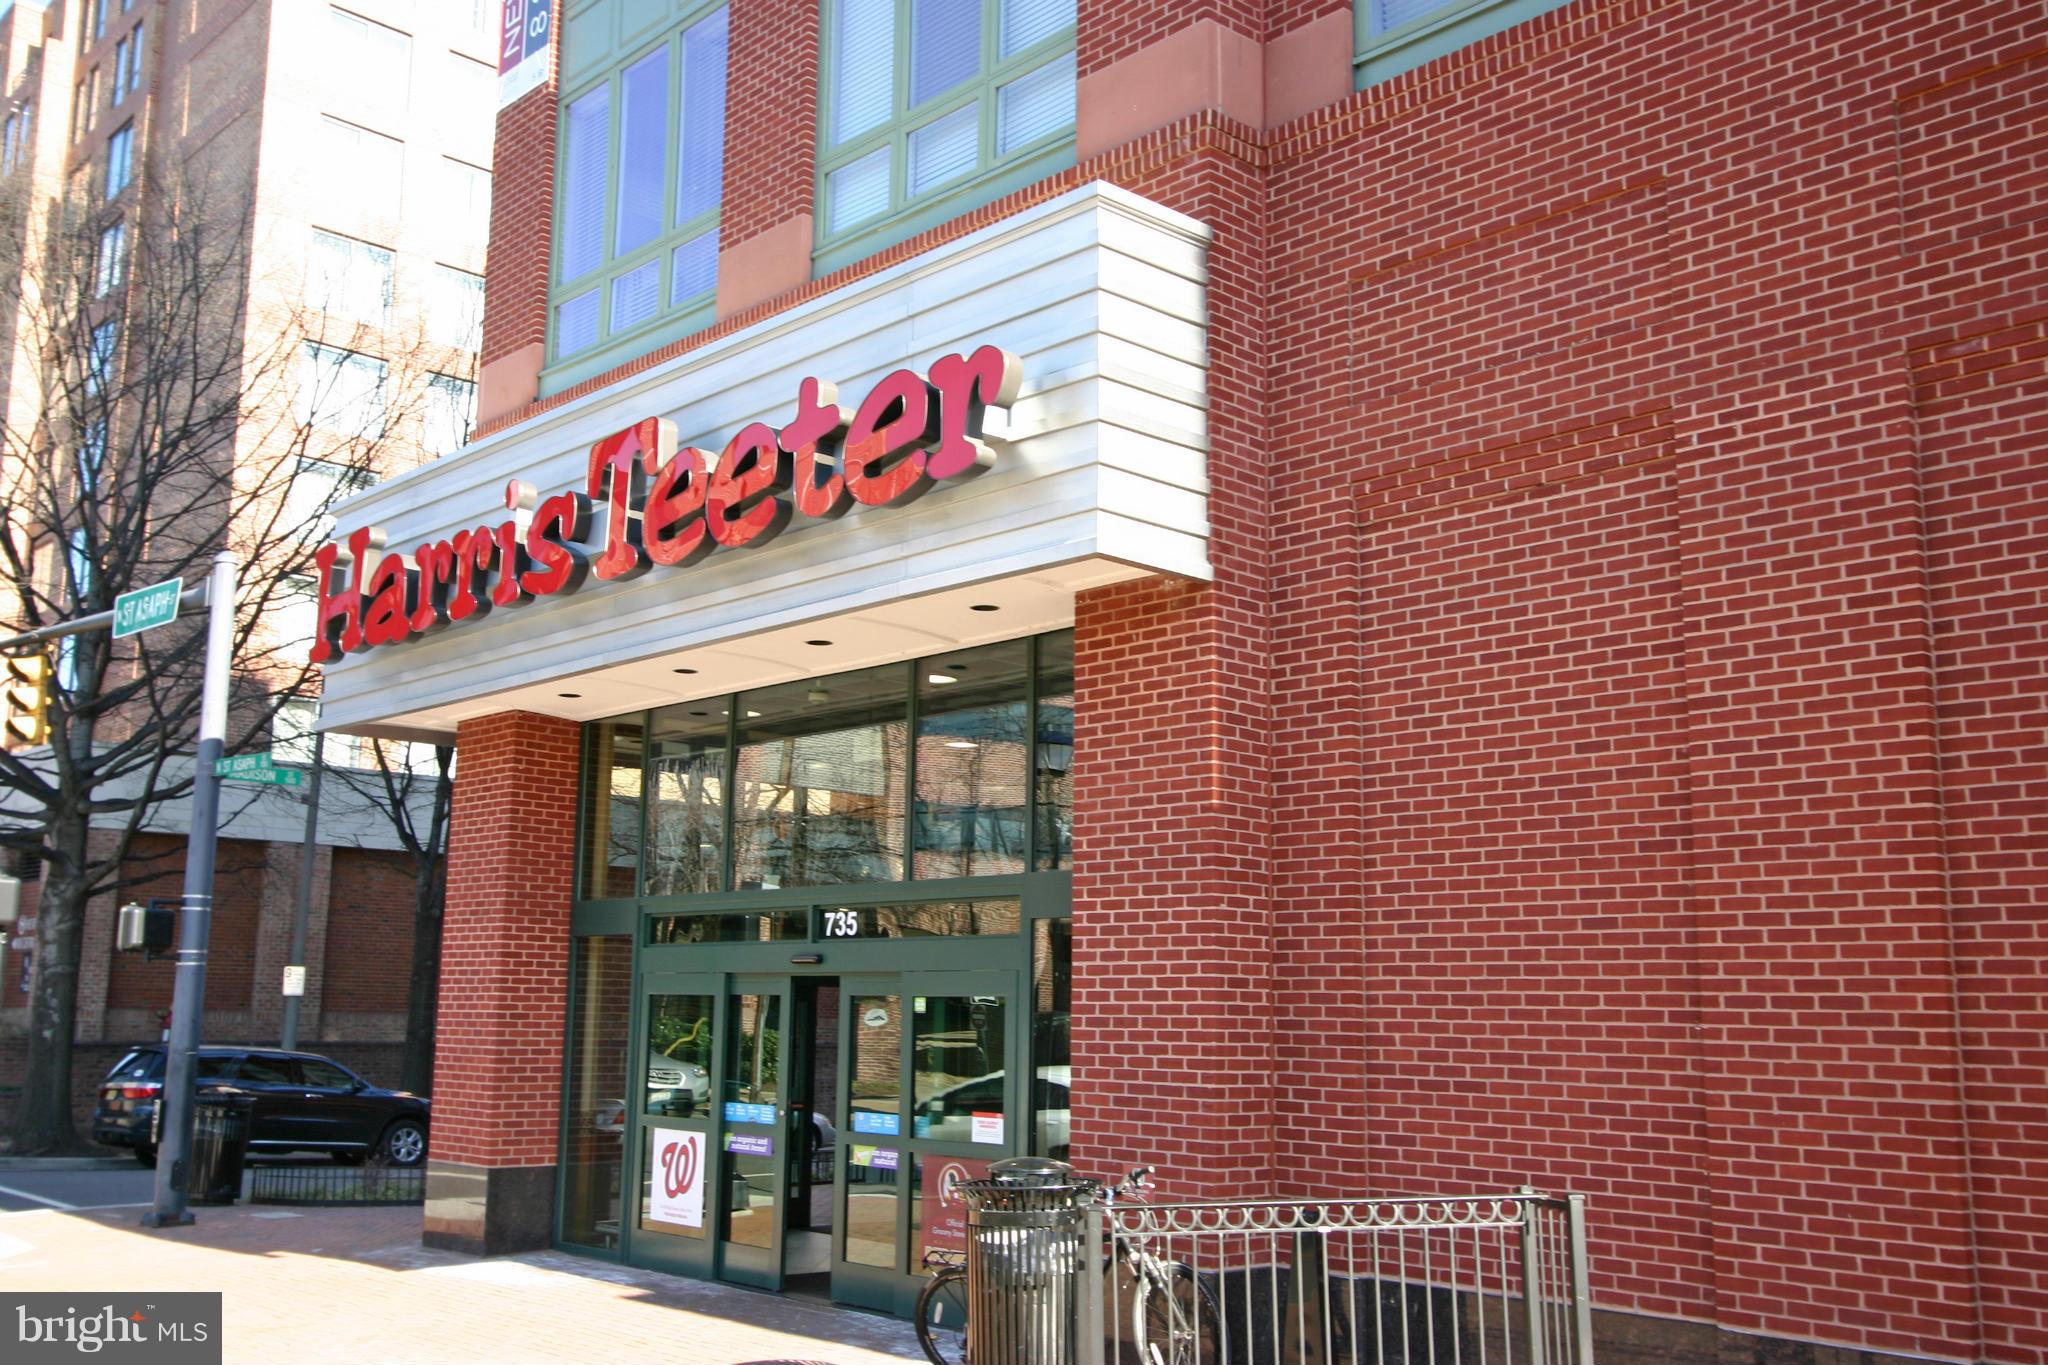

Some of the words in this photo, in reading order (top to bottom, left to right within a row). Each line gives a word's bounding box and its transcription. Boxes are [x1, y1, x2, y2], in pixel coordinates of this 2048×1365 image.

[502, 0, 522, 58] NE
[310, 476, 590, 665] Harris
[586, 343, 1014, 583] Teeter
[122, 600, 136, 627] ST
[134, 590, 170, 623] ASAPH
[222, 759, 232, 773] ST
[232, 757, 256, 772] ASAPH
[824, 911, 858, 937] 735
[661, 1136, 698, 1199] W
